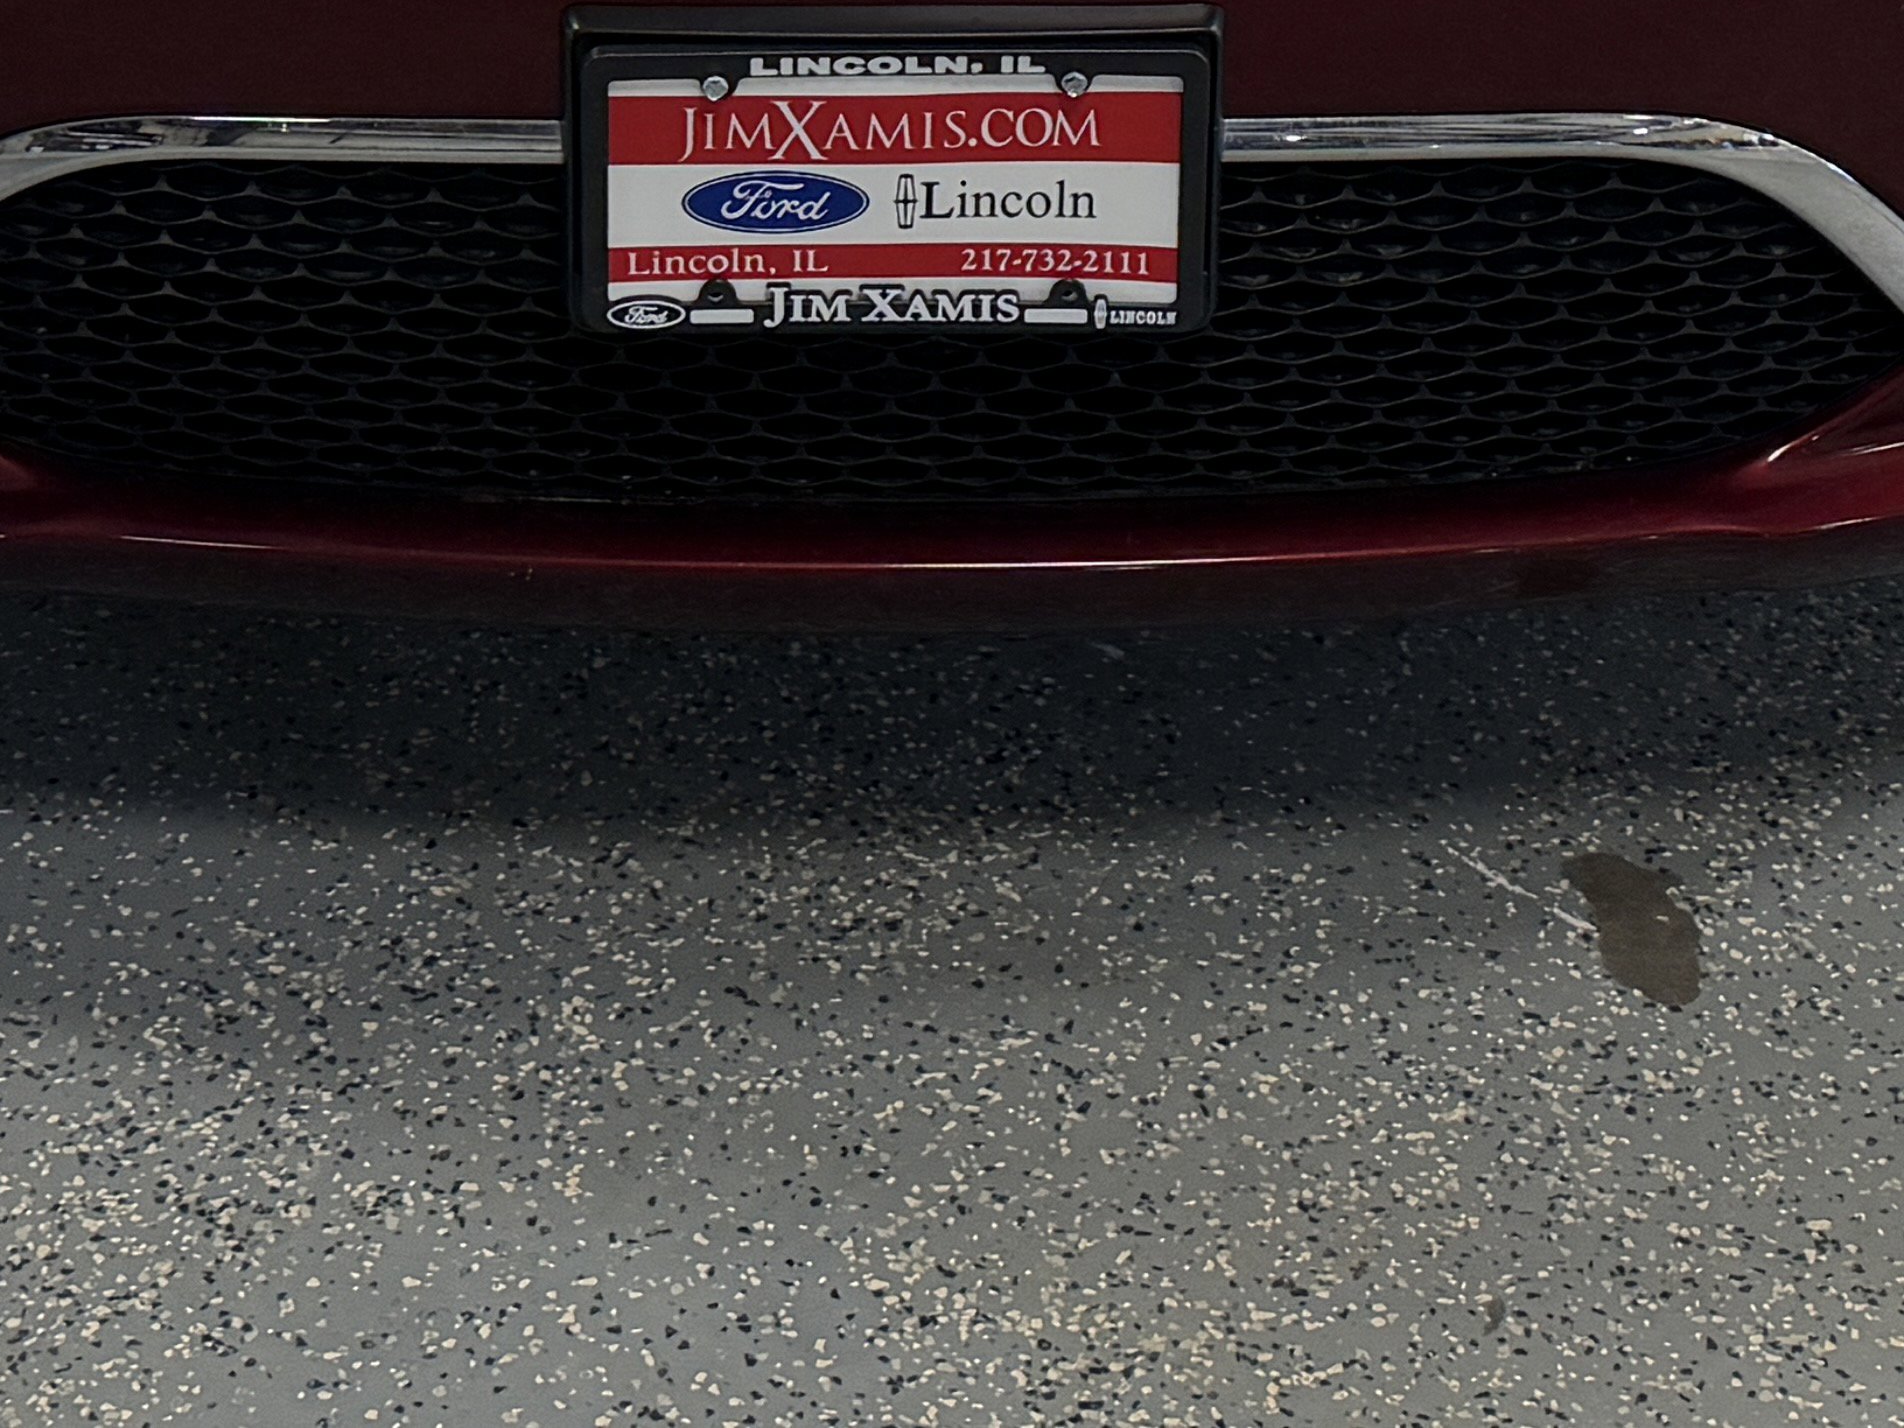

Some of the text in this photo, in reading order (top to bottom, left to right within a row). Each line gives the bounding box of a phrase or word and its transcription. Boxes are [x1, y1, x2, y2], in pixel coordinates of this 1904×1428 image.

[750, 56, 1046, 76] LINCOLN, IL
[720, 181, 831, 222] Ford
[920, 180, 1097, 220] Lincoln
[628, 250, 828, 276] Lincoln, IL
[961, 249, 1149, 275] 217-732-2111
[625, 305, 668, 326] Ford
[763, 288, 1019, 328] JIM XAMIS
[1110, 311, 1177, 324] LINCOLN
